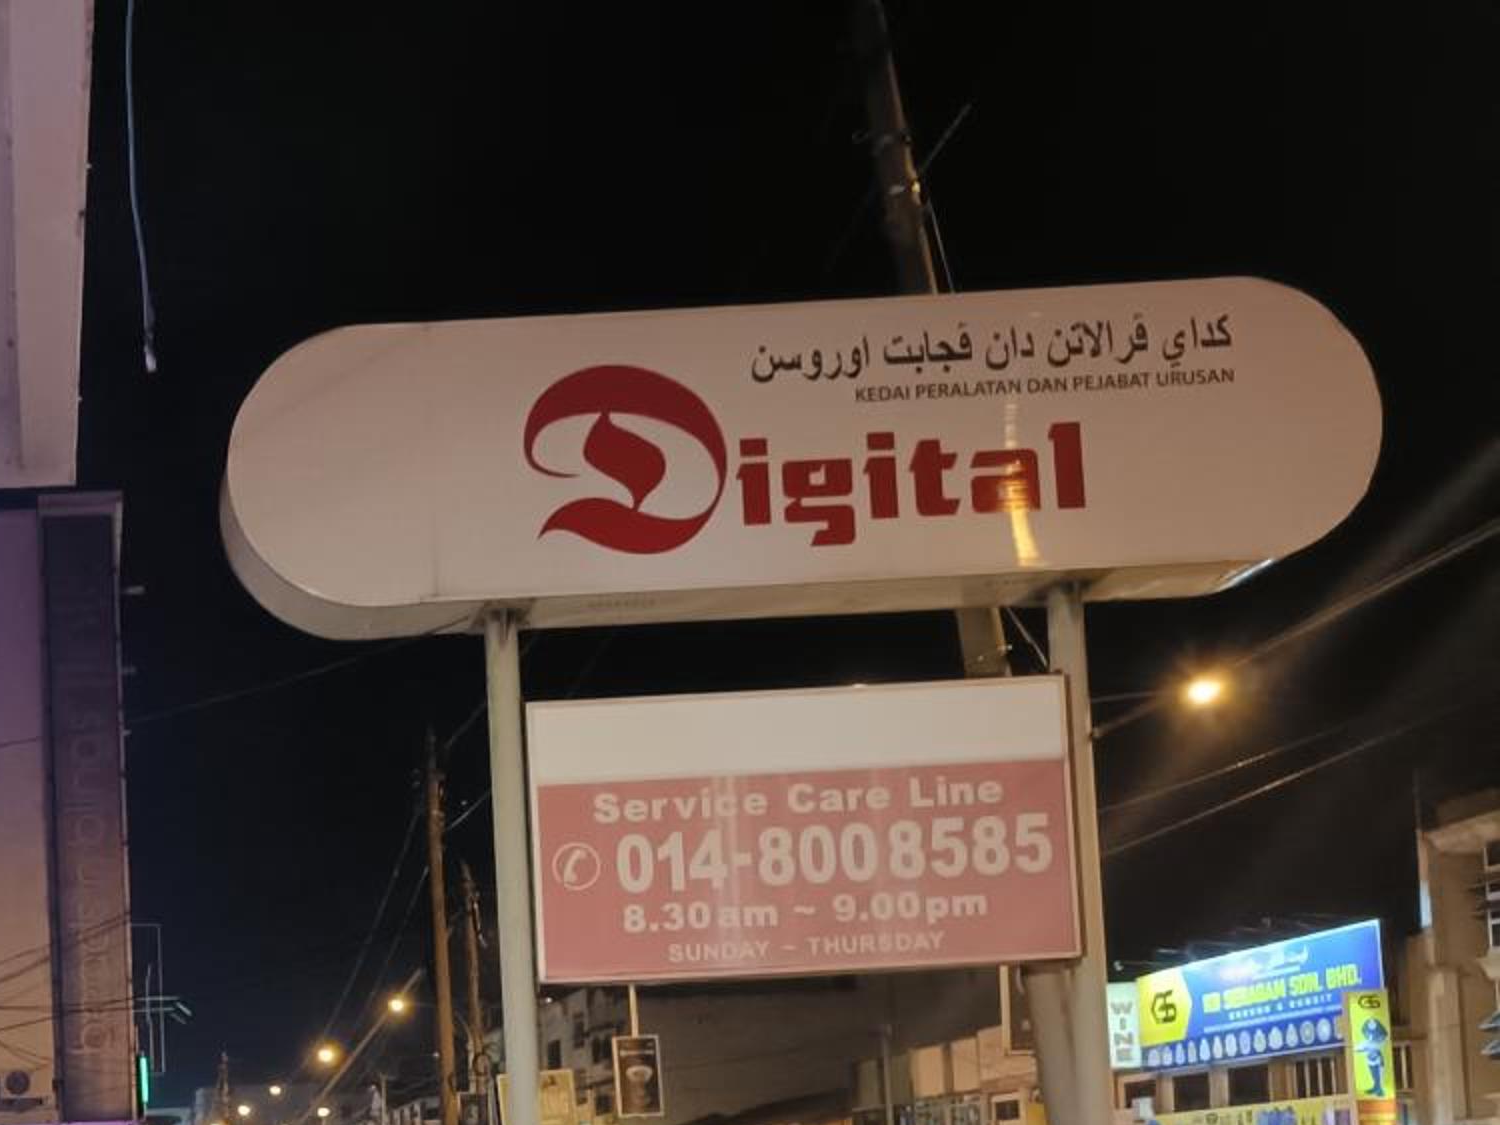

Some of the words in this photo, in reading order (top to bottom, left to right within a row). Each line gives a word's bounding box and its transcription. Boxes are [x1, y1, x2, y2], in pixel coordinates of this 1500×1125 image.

[855, 386, 911, 403] KEDAI
[915, 376, 1022, 400] PERALATAN
[1027, 376, 1068, 395] DAN
[1073, 372, 1151, 392] PEJABAT
[1157, 367, 1236, 387] URUSAN
[523, 364, 1087, 554] Digital
[593, 785, 768, 824] Service
[787, 779, 891, 815] Care
[909, 775, 1003, 808] Line
[622, 900, 779, 934] 8.30am
[831, 892, 988, 926] 9.00pm
[668, 940, 771, 964] SUNDAY
[808, 929, 945, 958] THURSDAY
